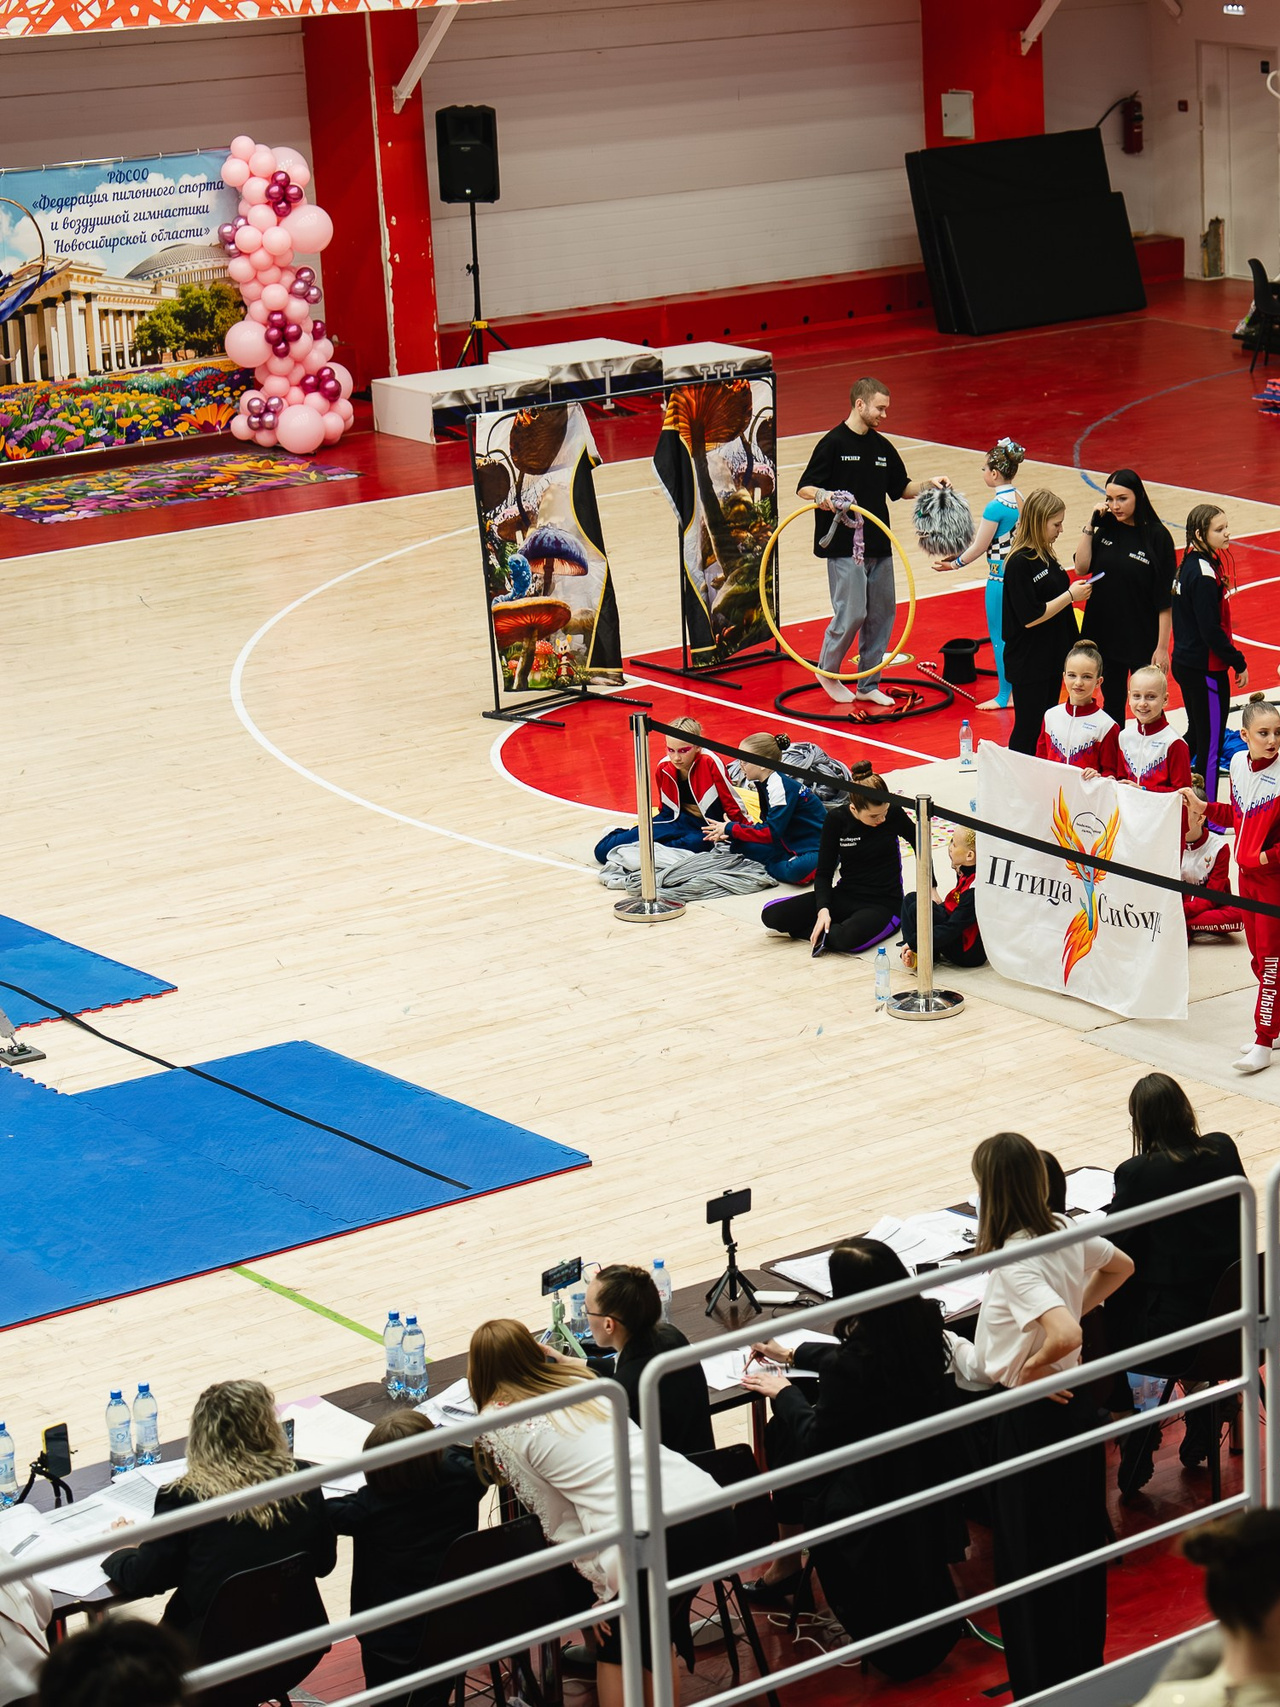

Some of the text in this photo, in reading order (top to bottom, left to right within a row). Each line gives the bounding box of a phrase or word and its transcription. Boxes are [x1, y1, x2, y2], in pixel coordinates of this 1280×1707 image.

[107, 167, 149, 184] РФСОО
[32, 180, 225, 213] «Федерация пилонного спорта
[50, 204, 210, 234] и воздушной гимнастики
[53, 227, 210, 253] Новосибирской области»
[985, 856, 1072, 906] Птица
